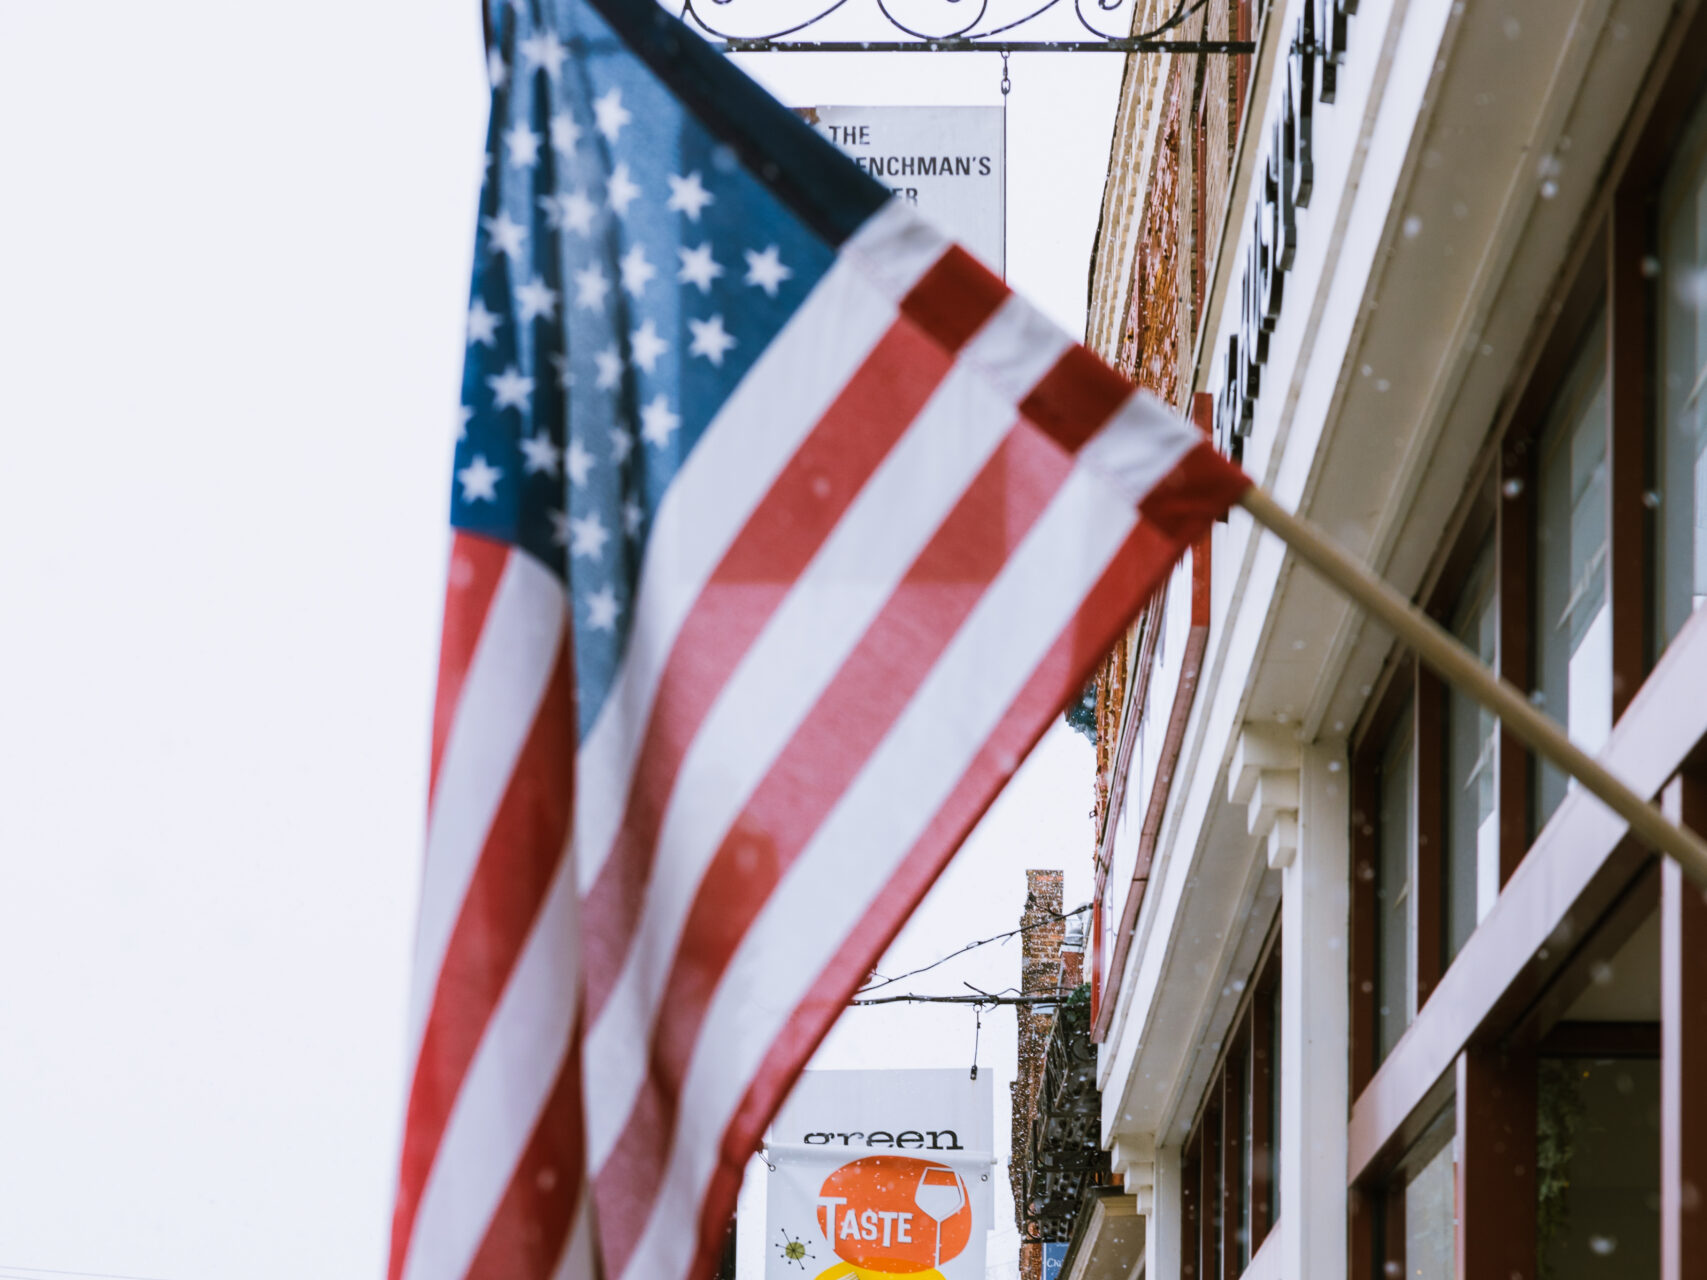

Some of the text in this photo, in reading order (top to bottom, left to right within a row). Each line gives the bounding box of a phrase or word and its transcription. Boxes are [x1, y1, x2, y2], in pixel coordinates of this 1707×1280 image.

[828, 126, 871, 145] THE
[855, 156, 991, 176] ENCHMAN'S
[803, 1130, 964, 1150] green
[816, 1196, 914, 1250] TASTE
